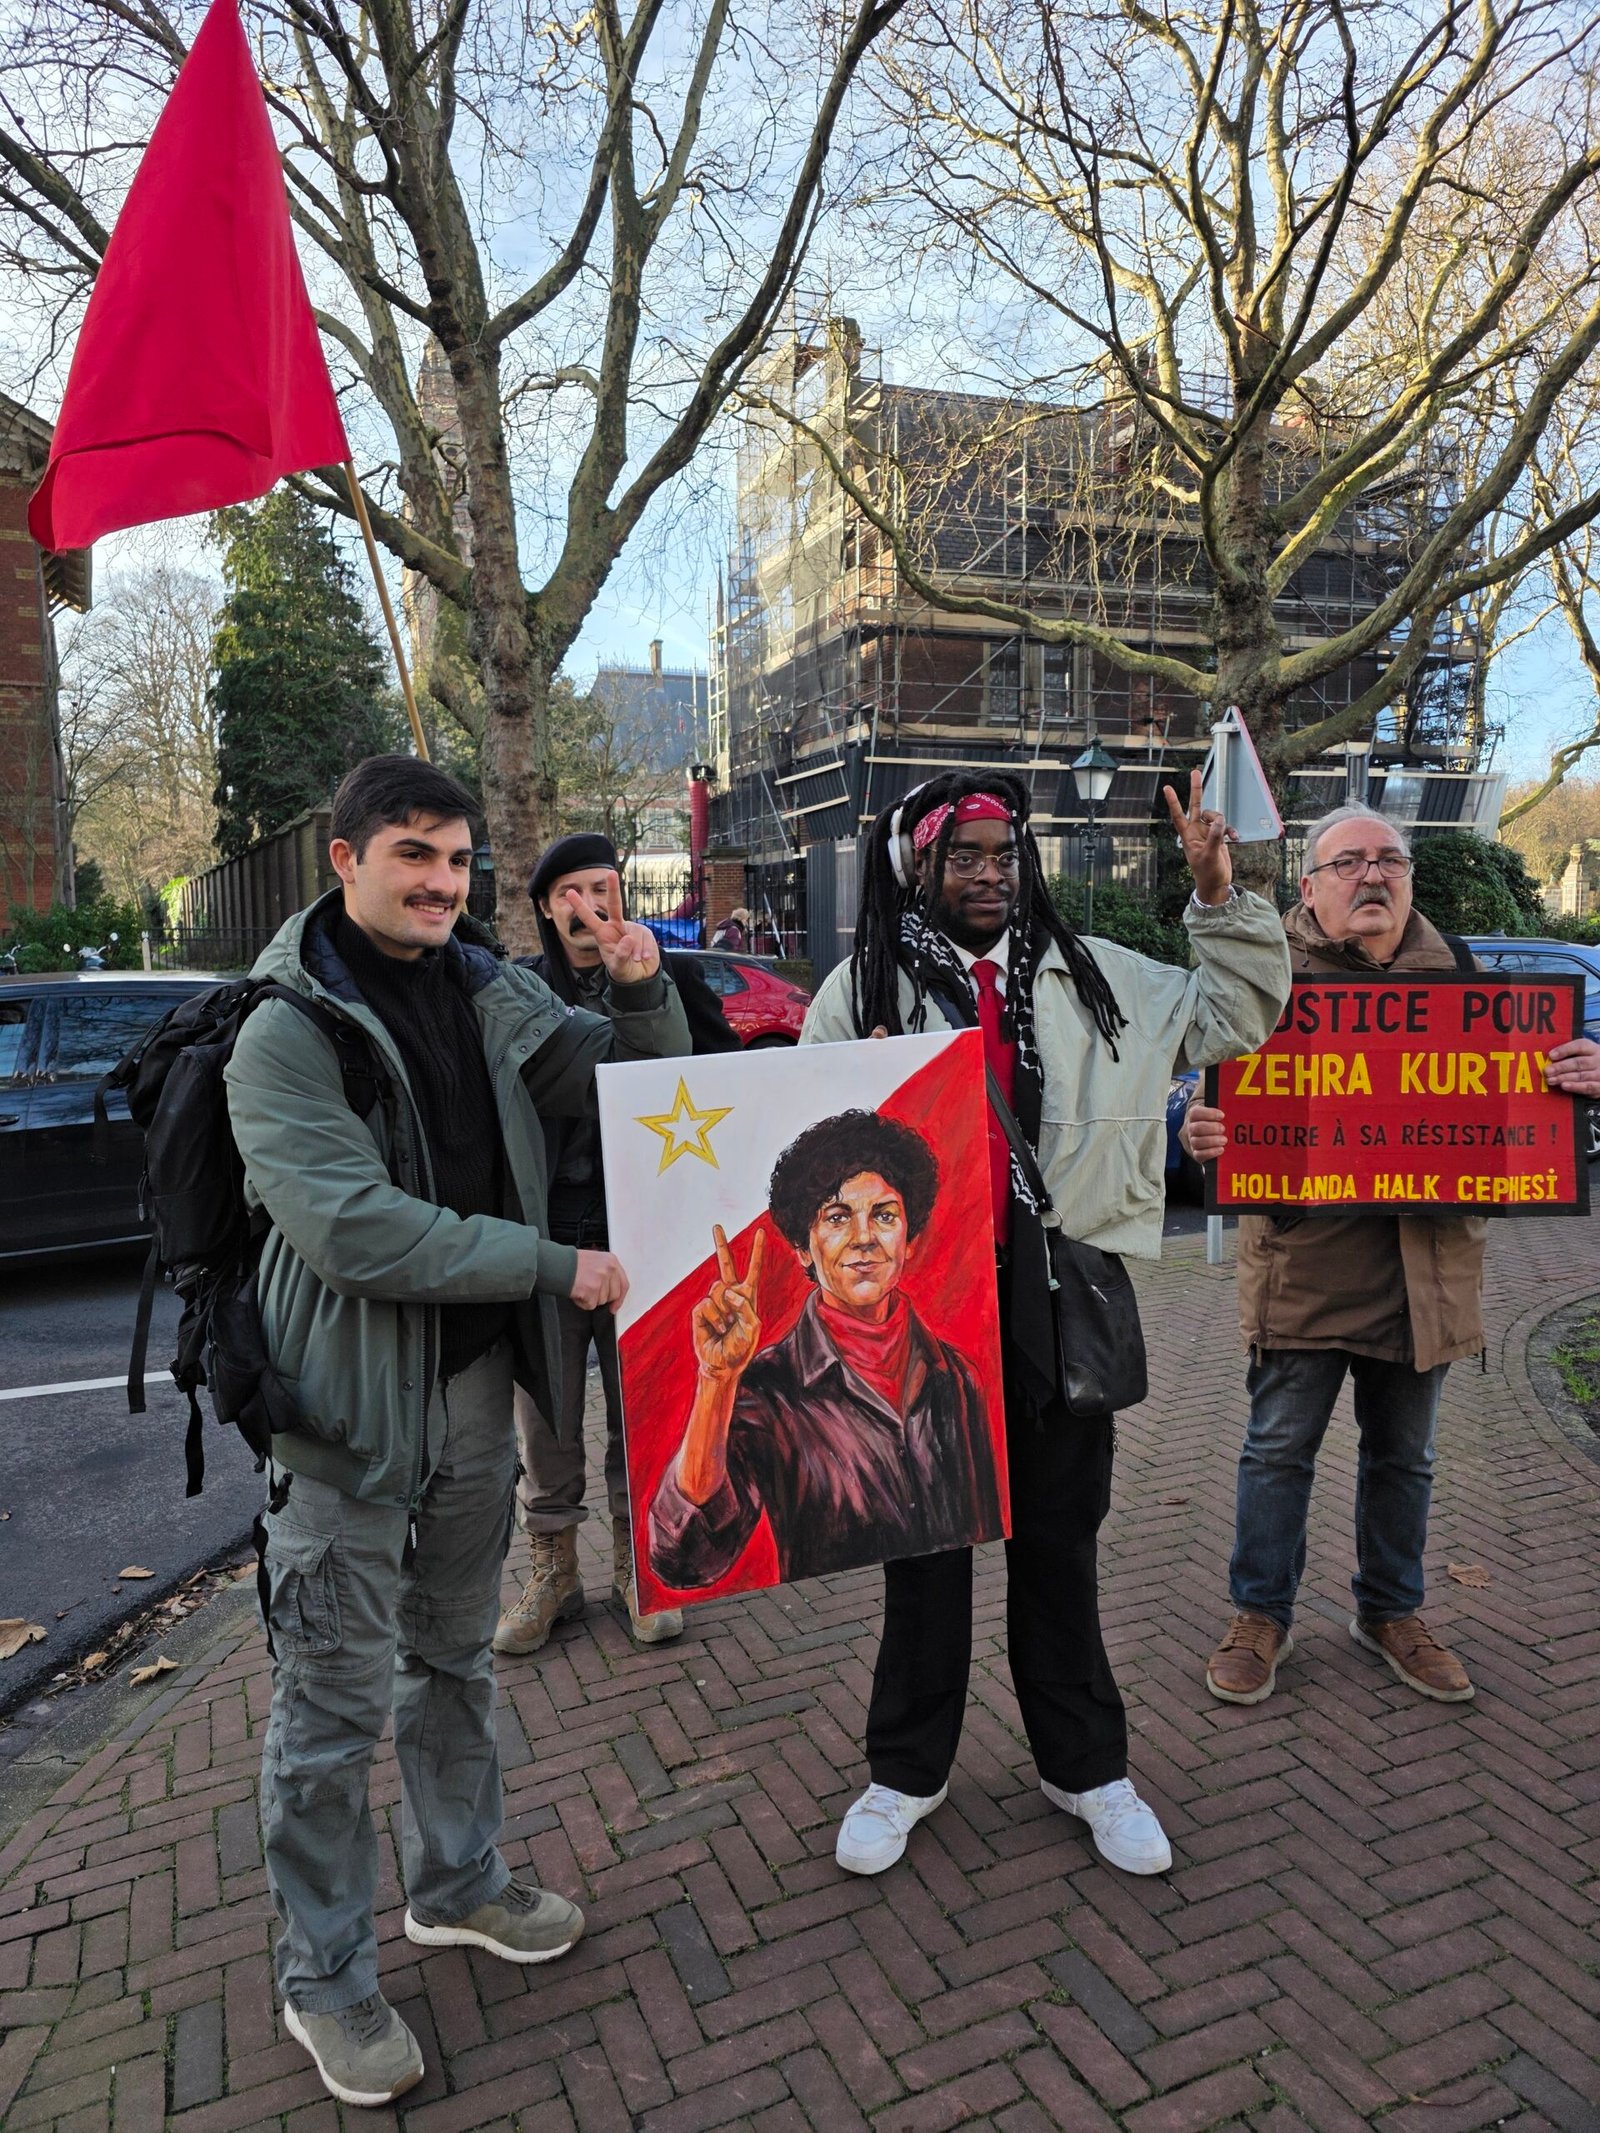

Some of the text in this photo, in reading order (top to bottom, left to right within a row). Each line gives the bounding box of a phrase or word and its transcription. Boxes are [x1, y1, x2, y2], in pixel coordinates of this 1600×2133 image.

[1274, 991, 1557, 1034] USTICE POUR
[1235, 1051, 1554, 1097] ZEHRA KURTAY
[1233, 1118, 1557, 1147] GLOIRE À SA RÉSISTANCE !
[1231, 1173, 1357, 1200] HOLLANDA
[1374, 1173, 1441, 1200] HALK
